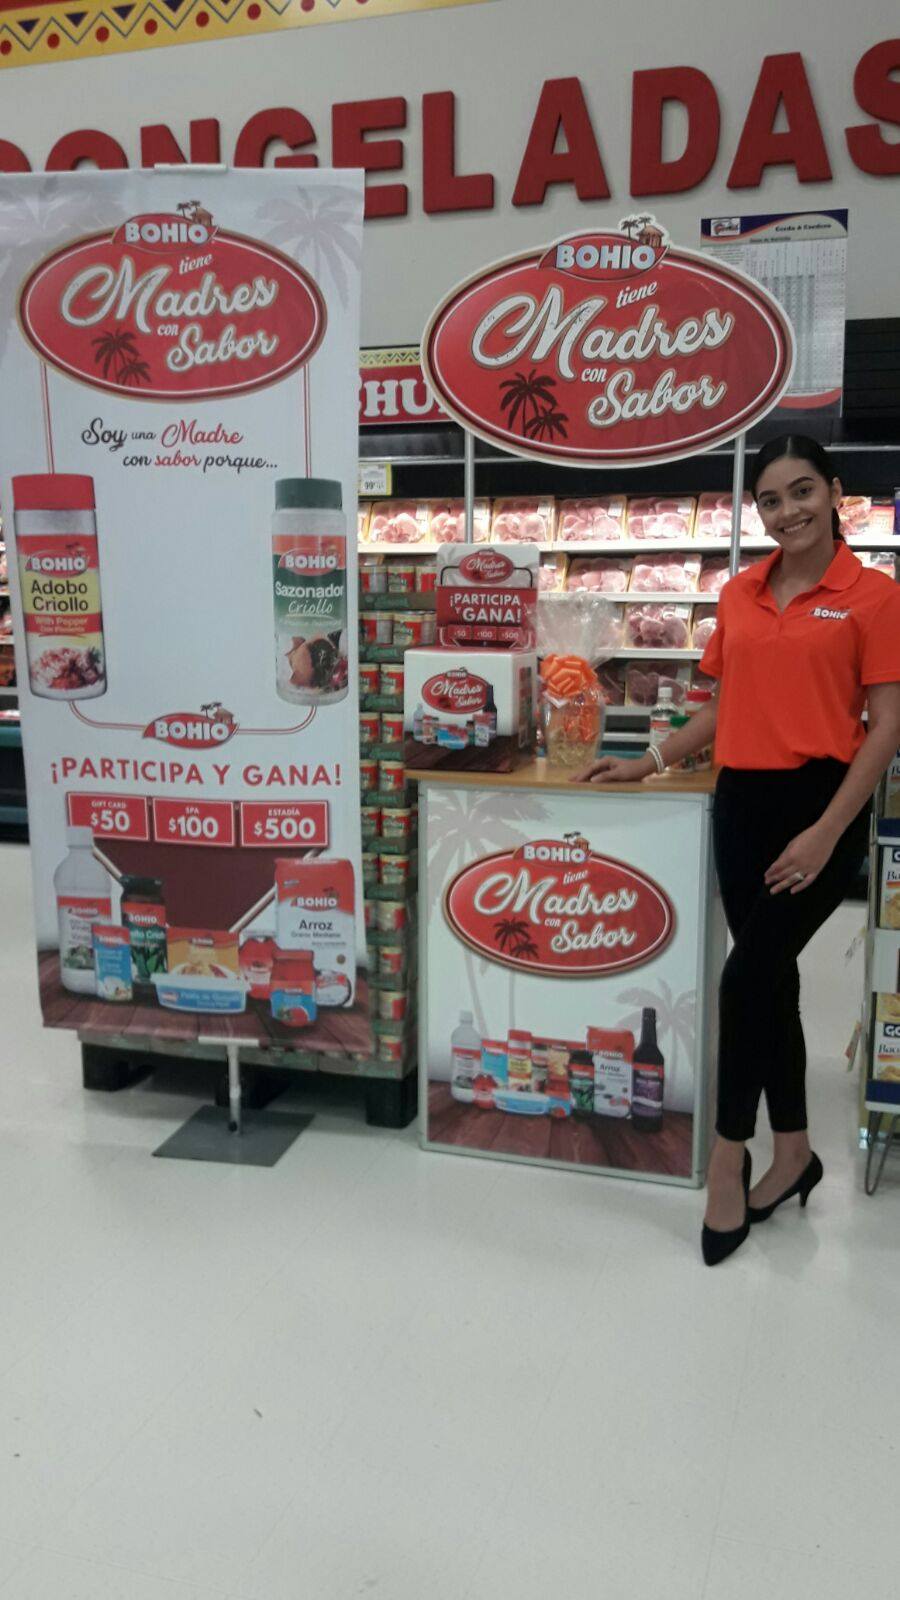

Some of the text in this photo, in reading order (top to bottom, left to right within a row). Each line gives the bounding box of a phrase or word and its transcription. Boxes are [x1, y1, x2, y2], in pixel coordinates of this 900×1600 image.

[125, 222, 208, 244] BOHIO
[179, 253, 212, 275] tiene
[556, 245, 655, 269] BOHIO
[61, 257, 278, 333] Madres
[616, 282, 657, 309] tiene
[157, 324, 179, 337] con
[472, 287, 734, 379] Madres
[168, 325, 278, 372] Sabor
[581, 368, 606, 382] con
[587, 370, 726, 428] Sabor
[82, 417, 243, 451] Soy una Madre
[123, 450, 278, 473] con sabor porque...
[31, 557, 86, 571] BOHIO
[285, 555, 337, 569] BOHIO
[31, 580, 88, 595] Adobo
[275, 581, 344, 598] Sazonador
[33, 596, 89, 612] Criollo
[288, 600, 333, 616] Criollo
[450, 593, 520, 607] ¡PARTICIPA
[462, 607, 521, 623] GANA!
[155, 721, 229, 741] BOHIO
[51, 757, 342, 787] ¡PARTICIPA Y GANA!
[91, 800, 127, 809] GIFT CARD
[91, 810, 130, 832] $50
[169, 817, 218, 839] $100
[254, 818, 316, 840] $500
[524, 846, 586, 863] BOHIO
[563, 870, 588, 884] tiene
[296, 896, 337, 907] BOHIO
[474, 868, 638, 925] Madres
[299, 920, 333, 931] Arroz
[545, 918, 560, 927] con
[551, 921, 637, 953] Sabor
